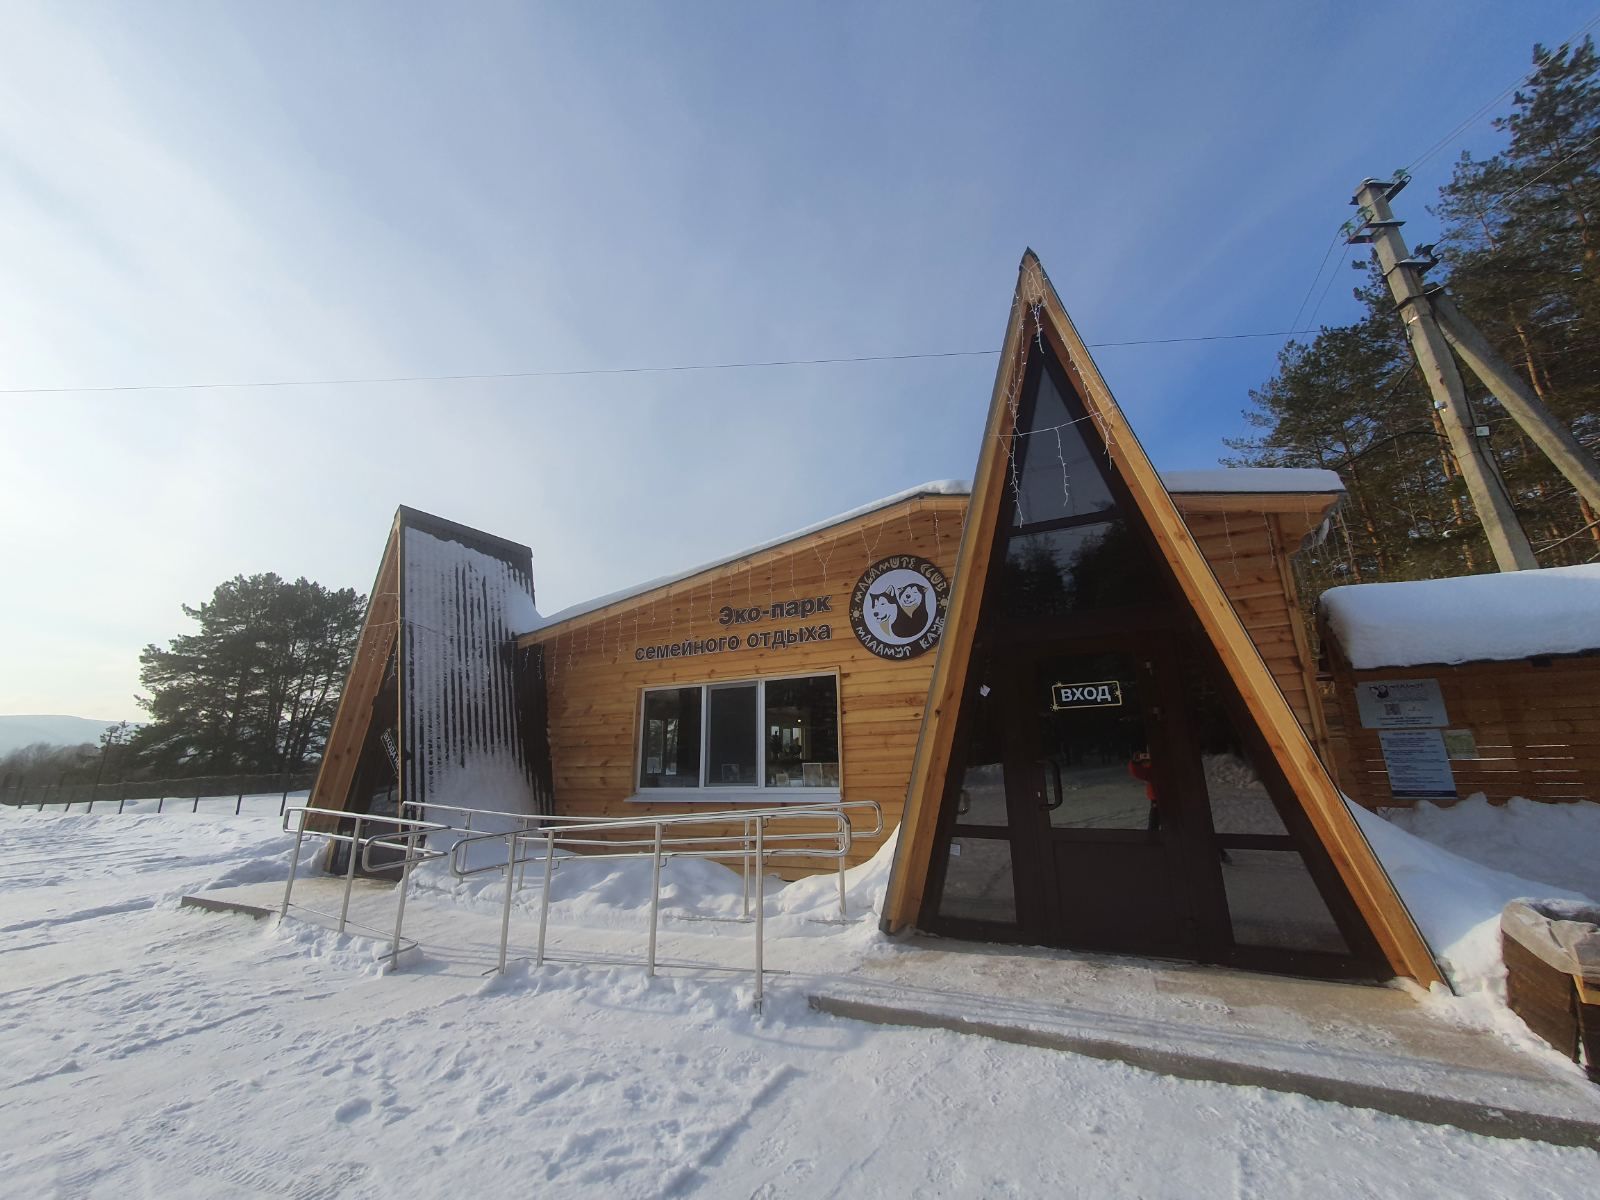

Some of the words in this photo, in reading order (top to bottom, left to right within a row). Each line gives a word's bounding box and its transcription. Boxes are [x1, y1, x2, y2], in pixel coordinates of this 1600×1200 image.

[719, 595, 832, 625] Эко-парк
[635, 634, 741, 661] семейного
[747, 624, 832, 651] отдыха
[1060, 685, 1112, 702] ВХОД
